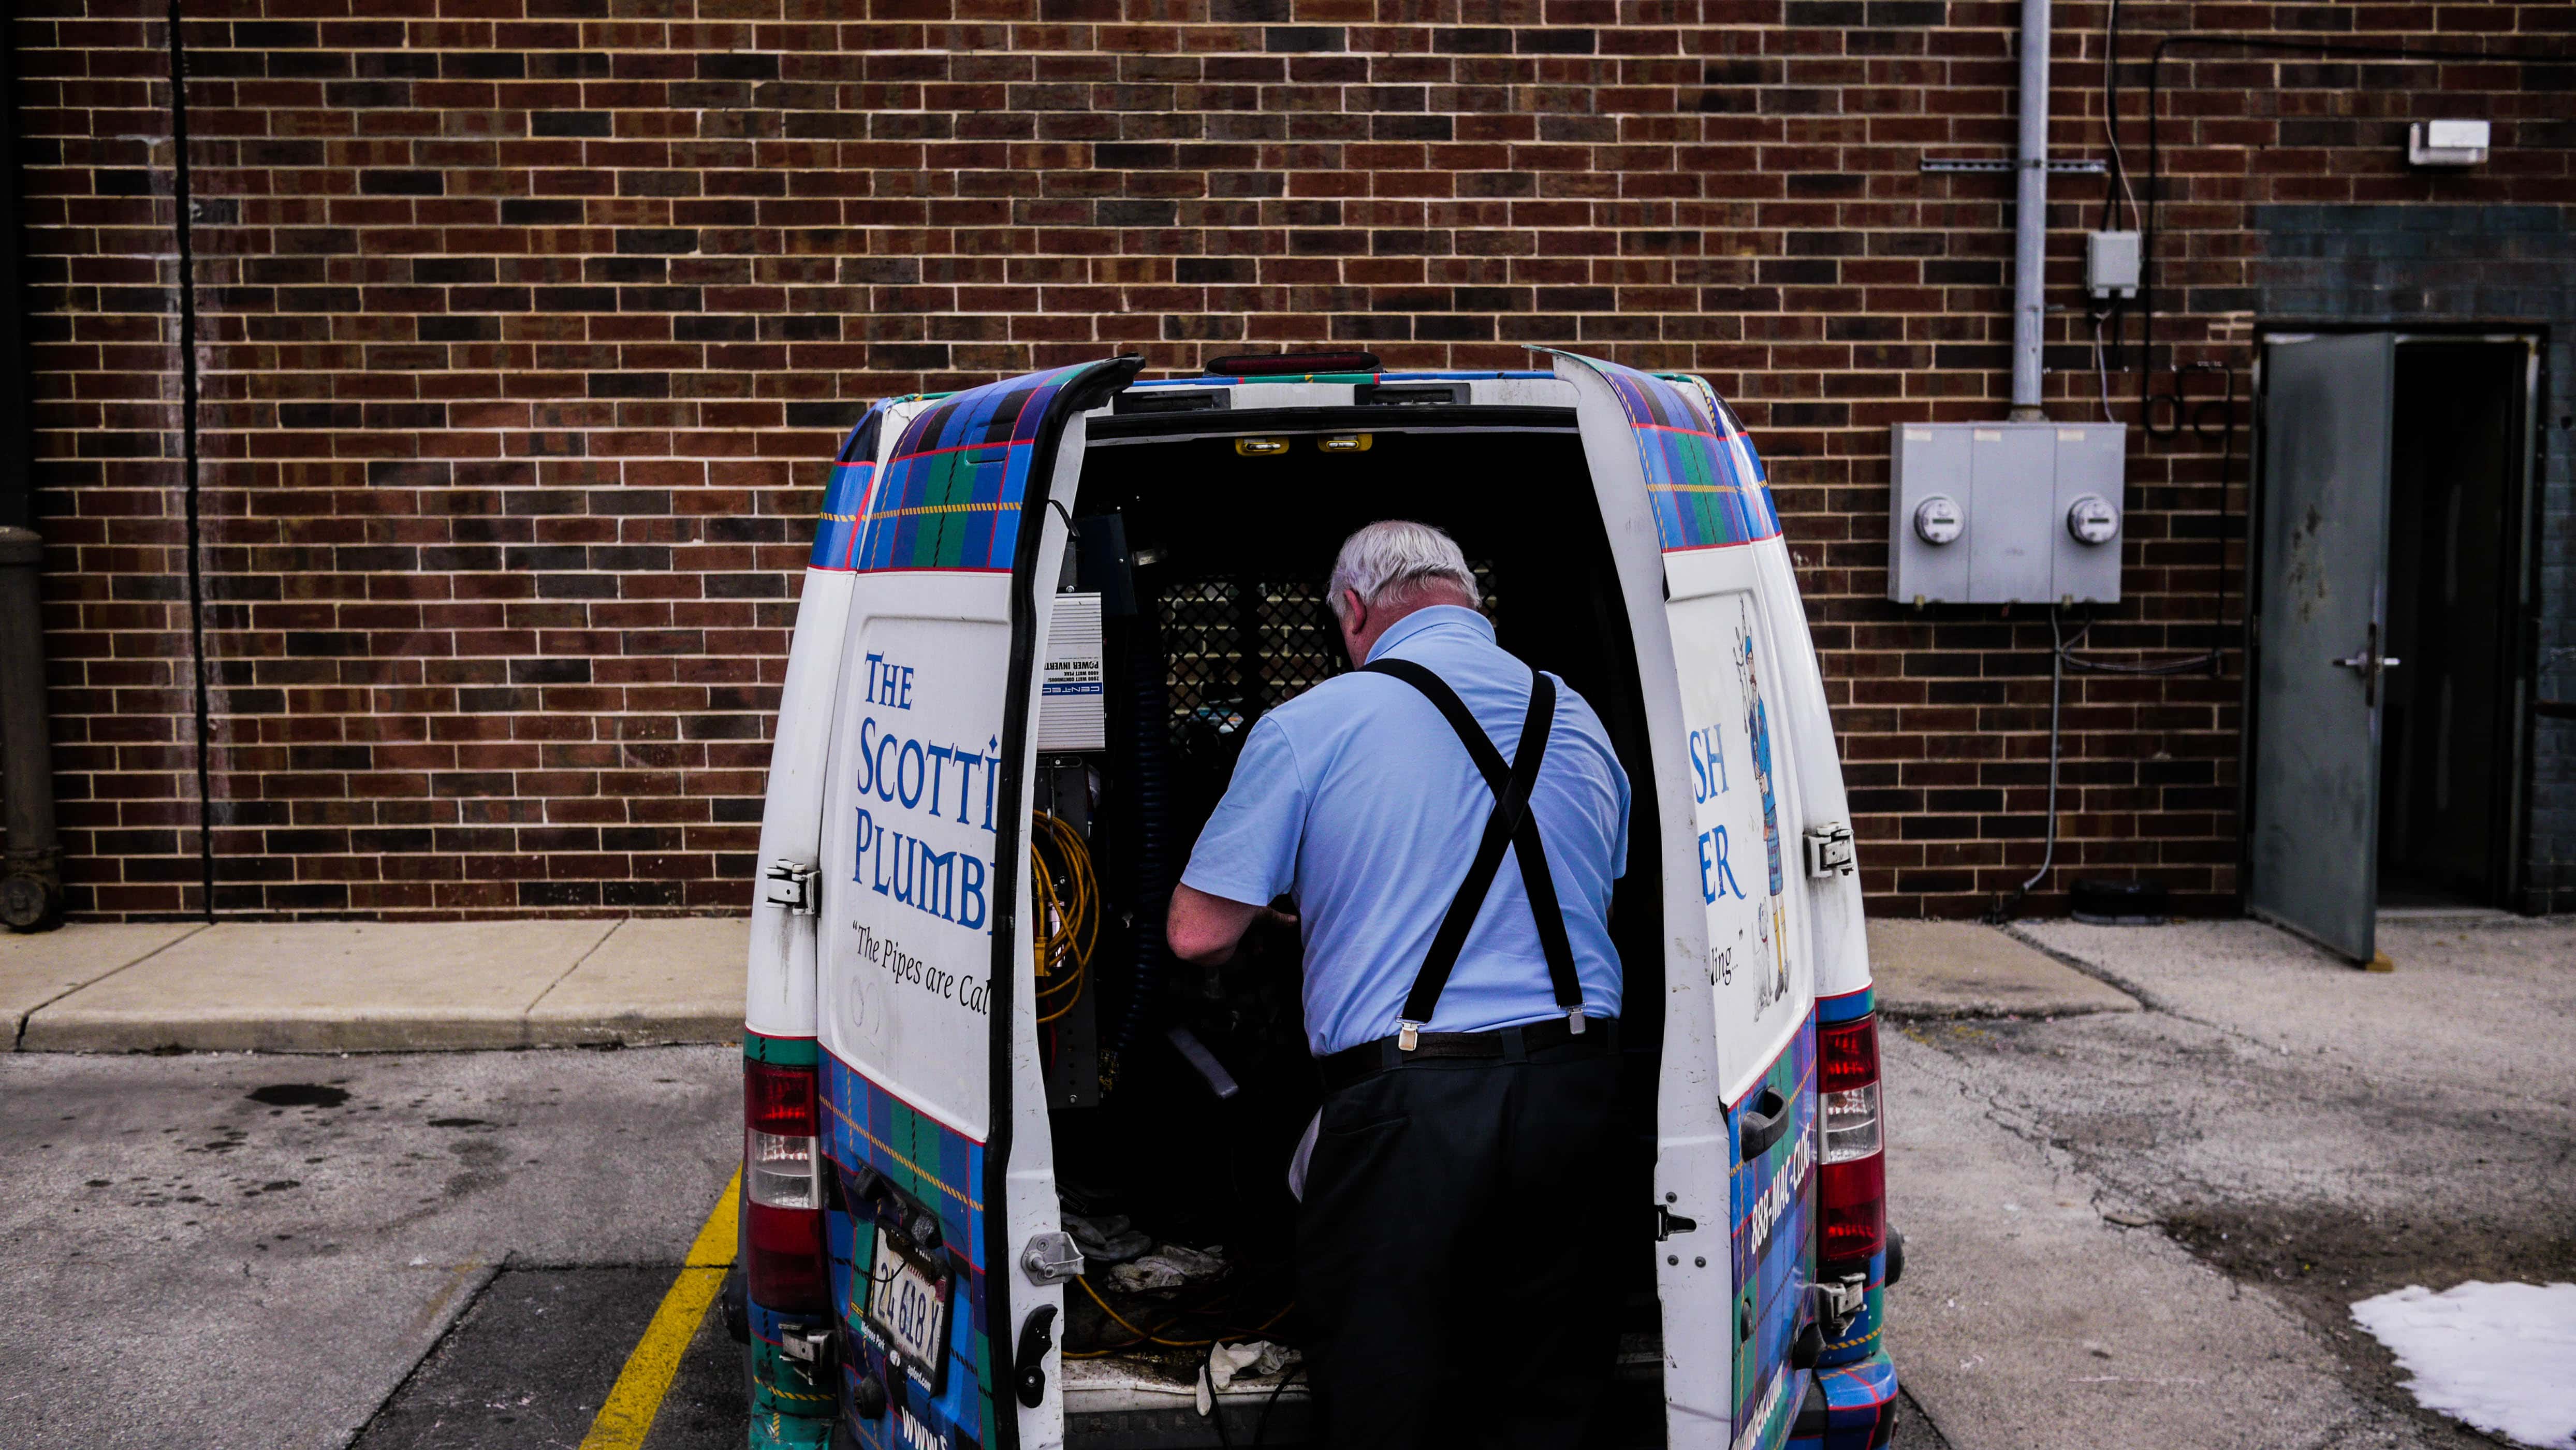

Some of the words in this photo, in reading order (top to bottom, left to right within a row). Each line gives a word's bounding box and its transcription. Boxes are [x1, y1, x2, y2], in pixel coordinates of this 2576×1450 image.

[865, 650, 914, 711] THE
[1044, 662, 1070, 670] INVERT
[1073, 661, 1099, 670] POWER
[1690, 723, 1729, 804] SH
[853, 806, 995, 935] PLUMB
[1699, 824, 1747, 906] ER
[882, 939, 923, 984] Pipes
[926, 967, 954, 998] are
